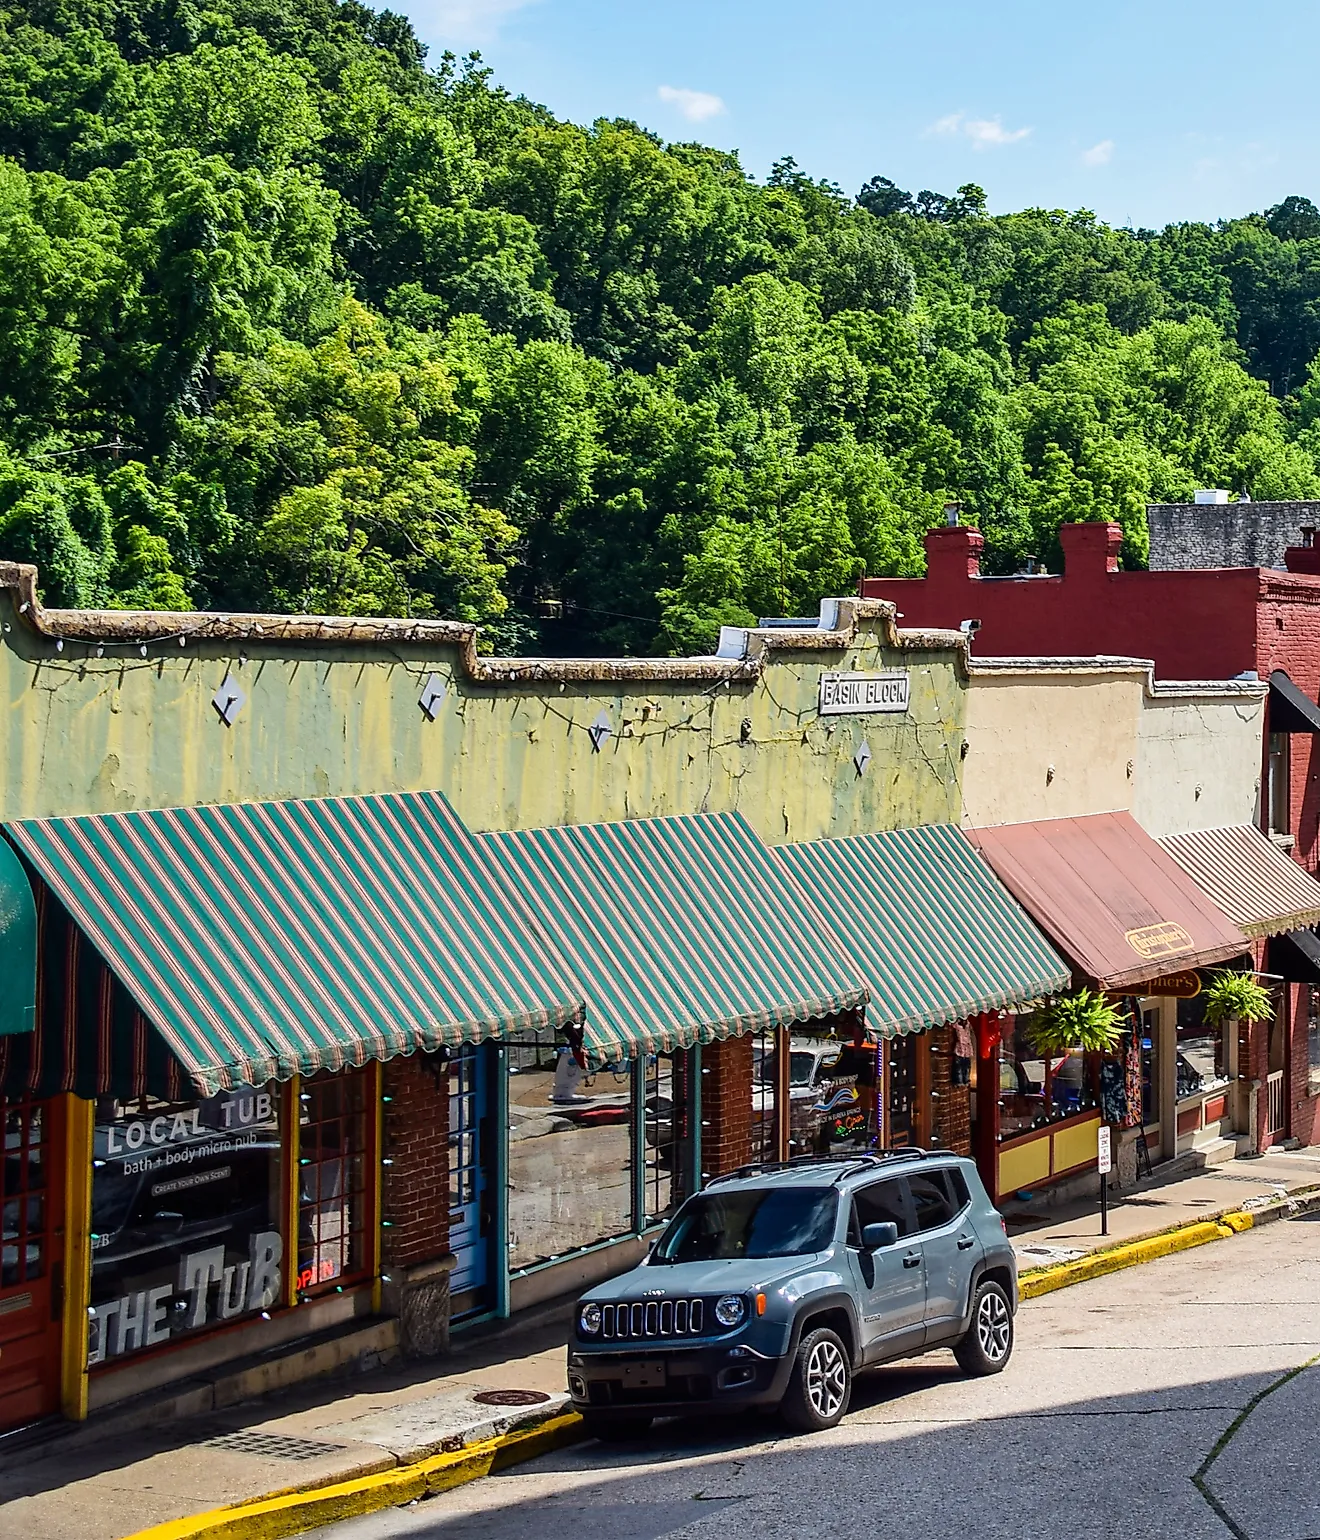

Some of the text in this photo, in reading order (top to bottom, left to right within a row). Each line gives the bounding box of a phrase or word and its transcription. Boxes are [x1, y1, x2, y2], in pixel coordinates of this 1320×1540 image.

[824, 681, 907, 705] BASIN BLOCK
[108, 1093, 272, 1154] LOCAL TUB
[123, 1156, 152, 1176] bath
[165, 1146, 195, 1165] body
[198, 1139, 231, 1158] micro
[235, 1132, 257, 1153] pub
[91, 1283, 173, 1363] THE
